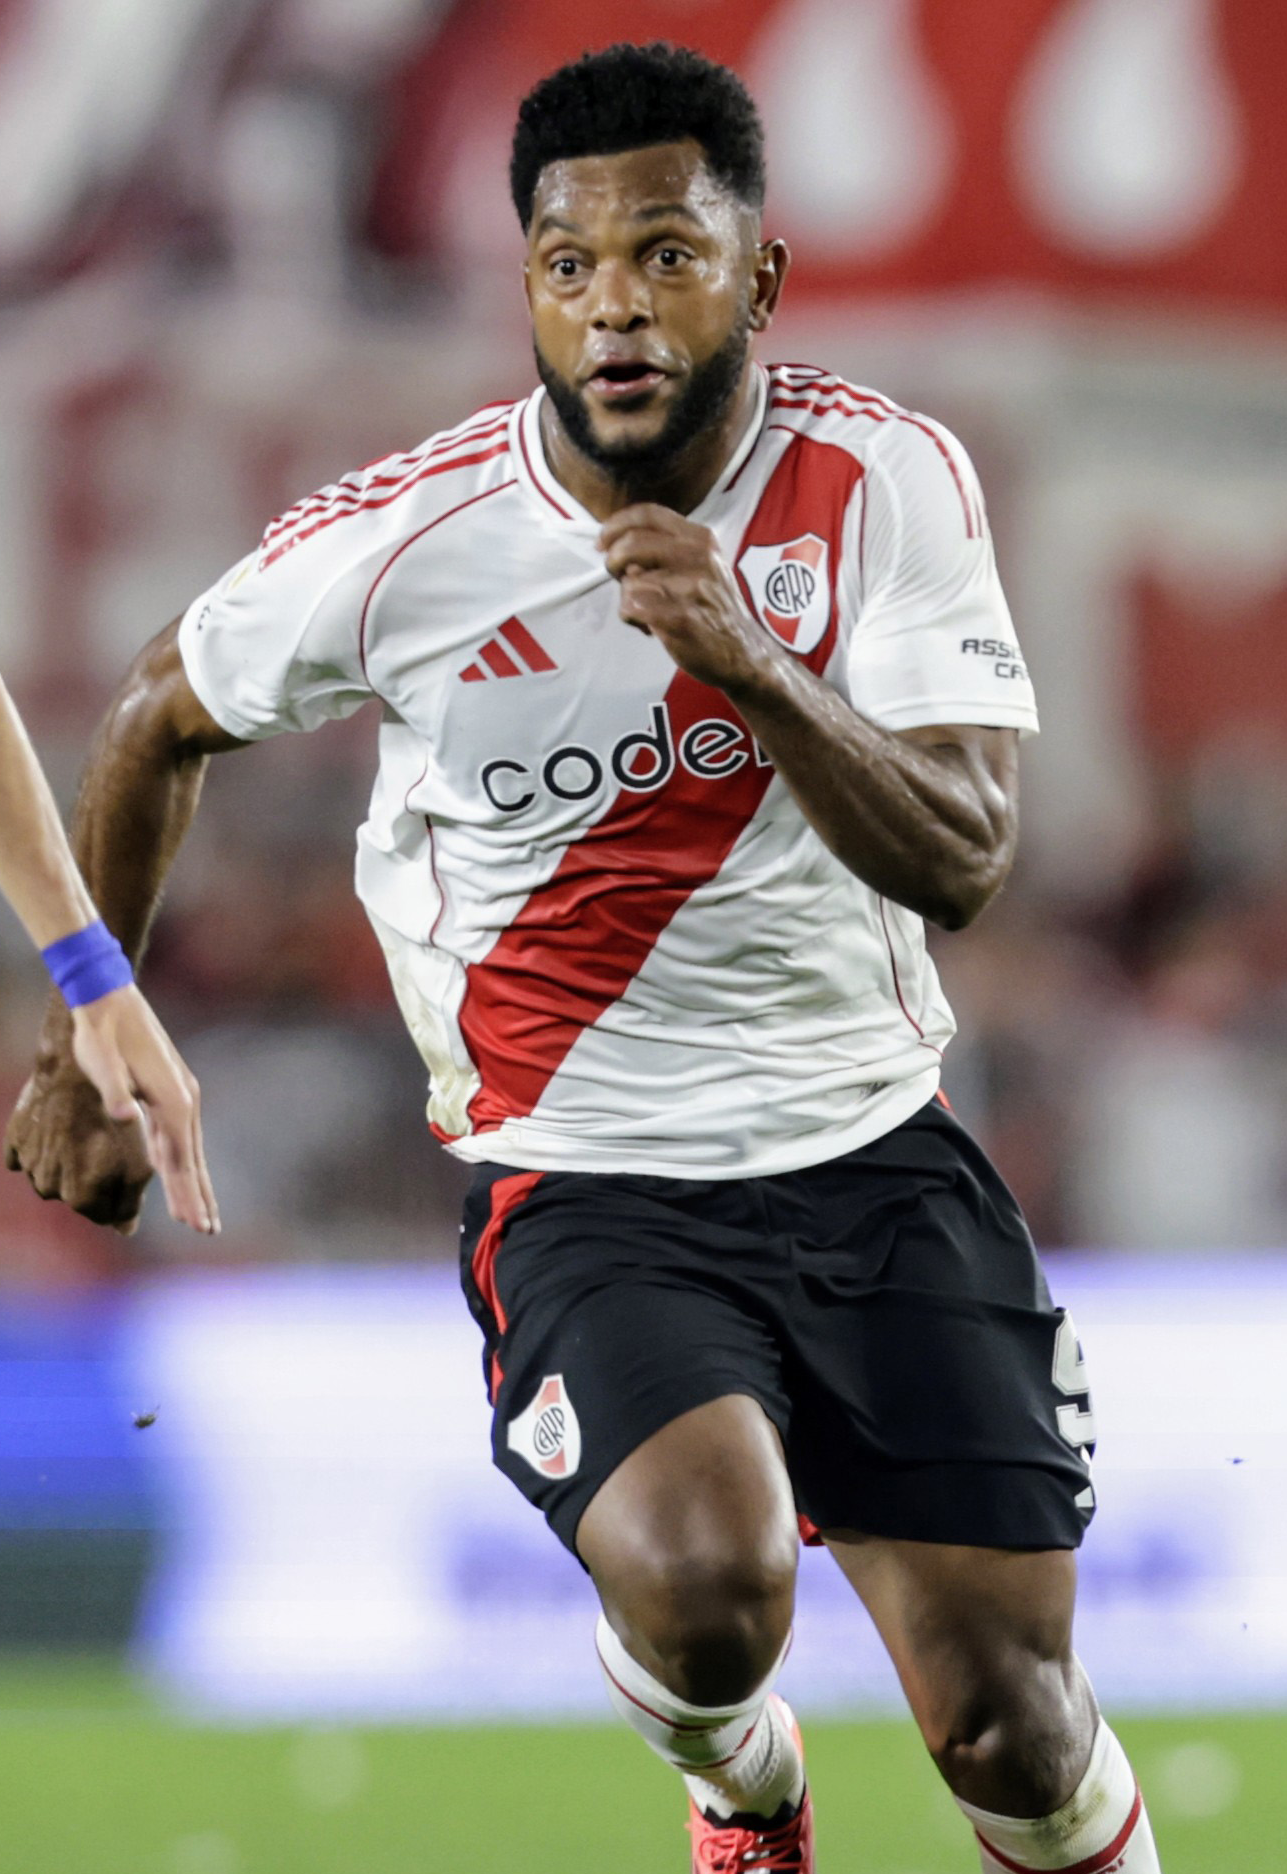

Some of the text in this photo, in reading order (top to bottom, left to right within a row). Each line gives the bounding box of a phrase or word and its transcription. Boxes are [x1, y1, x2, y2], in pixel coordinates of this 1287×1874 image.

[765, 562, 815, 614] CARP
[995, 661, 1027, 681] CA
[480, 701, 776, 814] code
[532, 1406, 565, 1457] CARP
